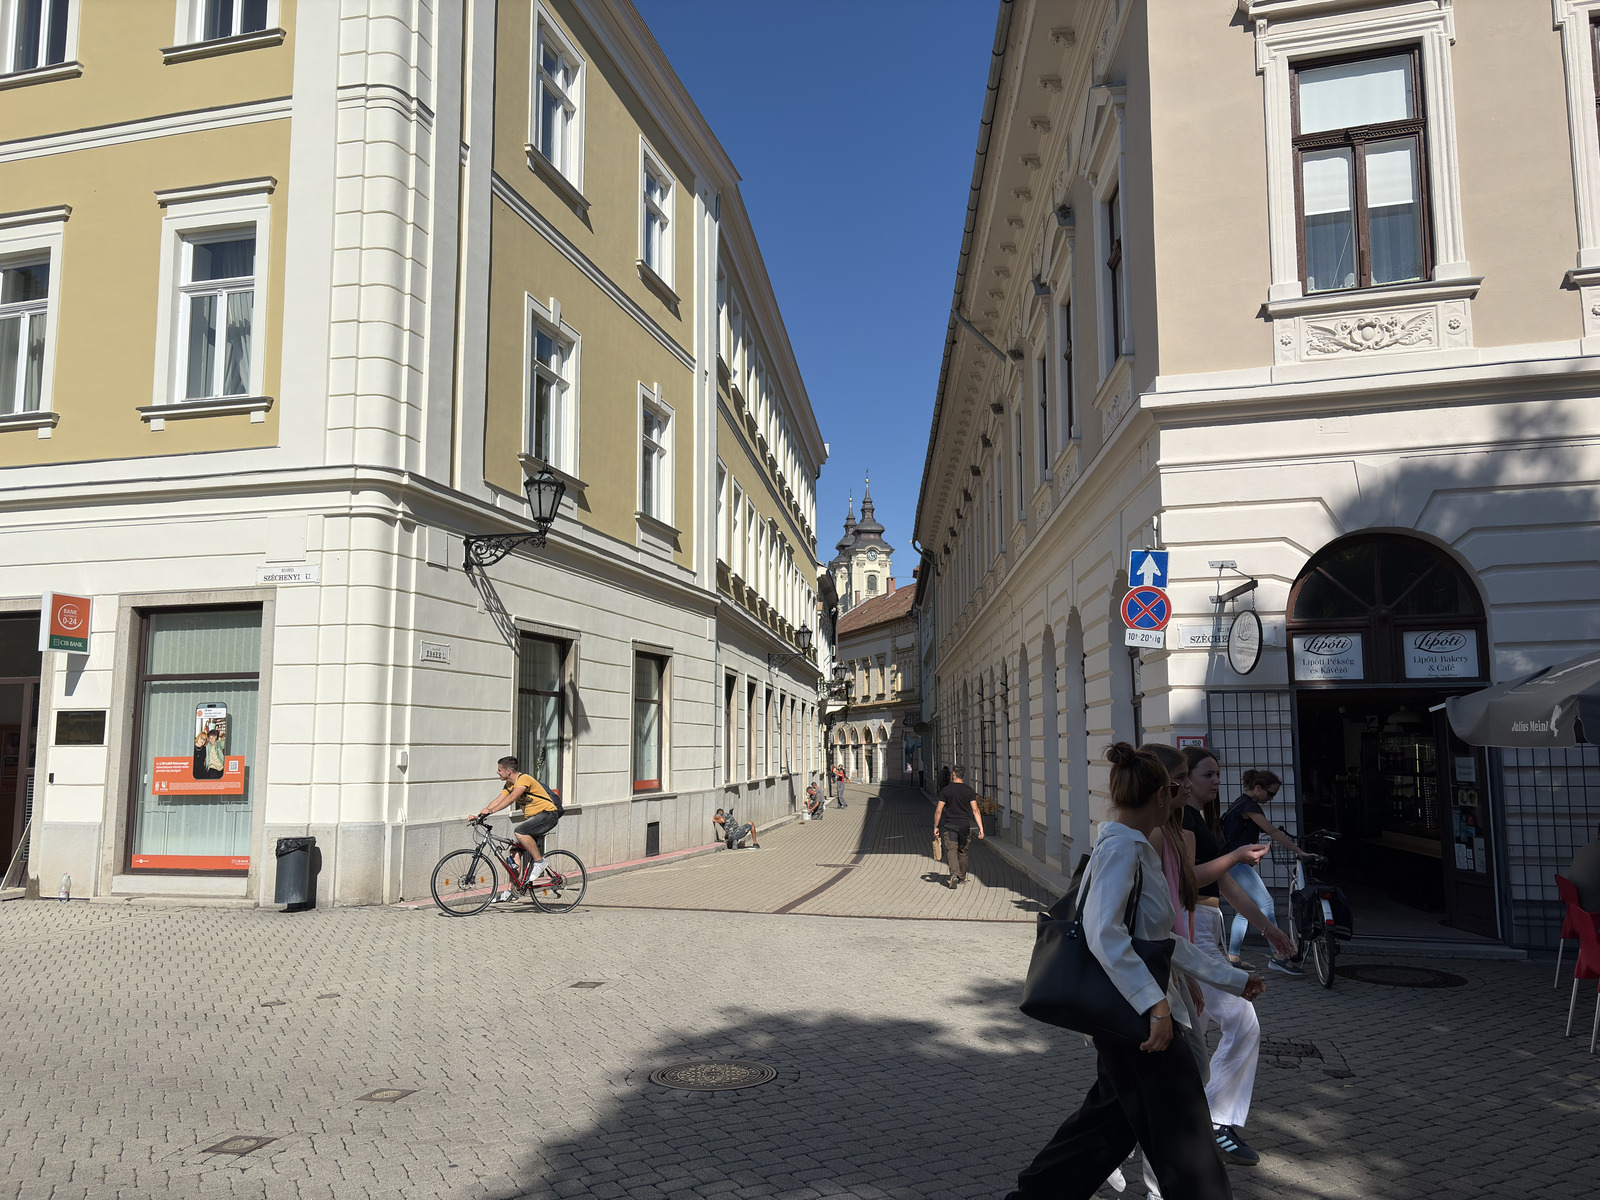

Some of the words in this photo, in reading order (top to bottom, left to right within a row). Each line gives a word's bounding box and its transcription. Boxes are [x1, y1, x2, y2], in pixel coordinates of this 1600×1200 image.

[62, 617, 77, 625] 0-24
[1304, 635, 1349, 653] Lipóti
[1415, 632, 1463, 651] Lipóti
[1302, 658, 1325, 666] Lipóti
[1327, 657, 1355, 666] Pékség
[1413, 656, 1437, 664] Lipóti
[1440, 655, 1469, 663] Bakery
[1321, 666, 1348, 674] Kávézó
[1428, 664, 1435, 672] &
[1436, 664, 1455, 672] Café
[1511, 721, 1529, 732] Julius
[1530, 720, 1549, 732] Meinl
